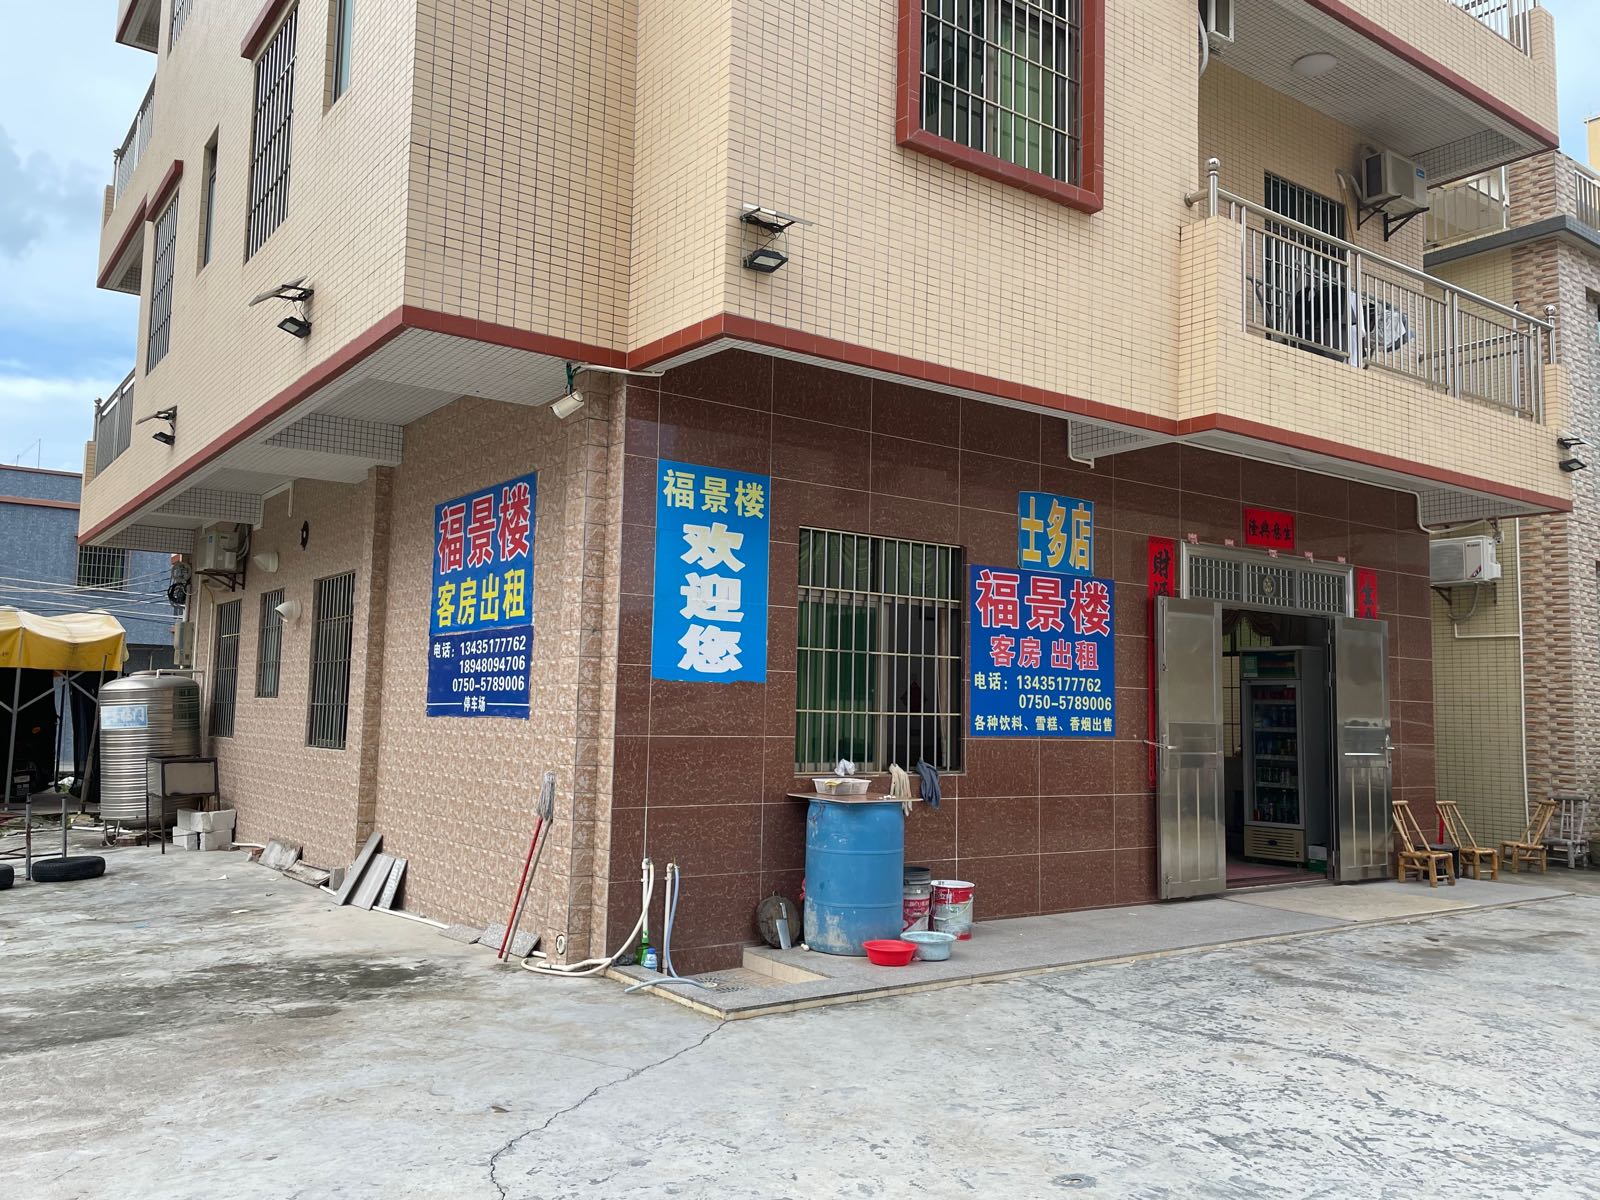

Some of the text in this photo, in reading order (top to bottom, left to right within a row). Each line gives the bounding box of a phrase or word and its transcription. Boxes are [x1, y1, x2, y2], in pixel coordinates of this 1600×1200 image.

[663, 469, 765, 519] 福景楼
[437, 482, 532, 575] 福景楼
[1020, 496, 1092, 571] 士多店
[436, 568, 526, 628] 客房出租
[975, 569, 1111, 638] 福景楼
[459, 635, 527, 656] 13435177762
[989, 634, 1099, 671] 客房出租
[459, 655, 526, 674] 18948094706
[452, 675, 525, 692] 0750-5789006
[1016, 675, 1102, 693] 13435177762
[463, 696, 486, 712] 停车场
[1018, 694, 1113, 711] 0750-5789006
